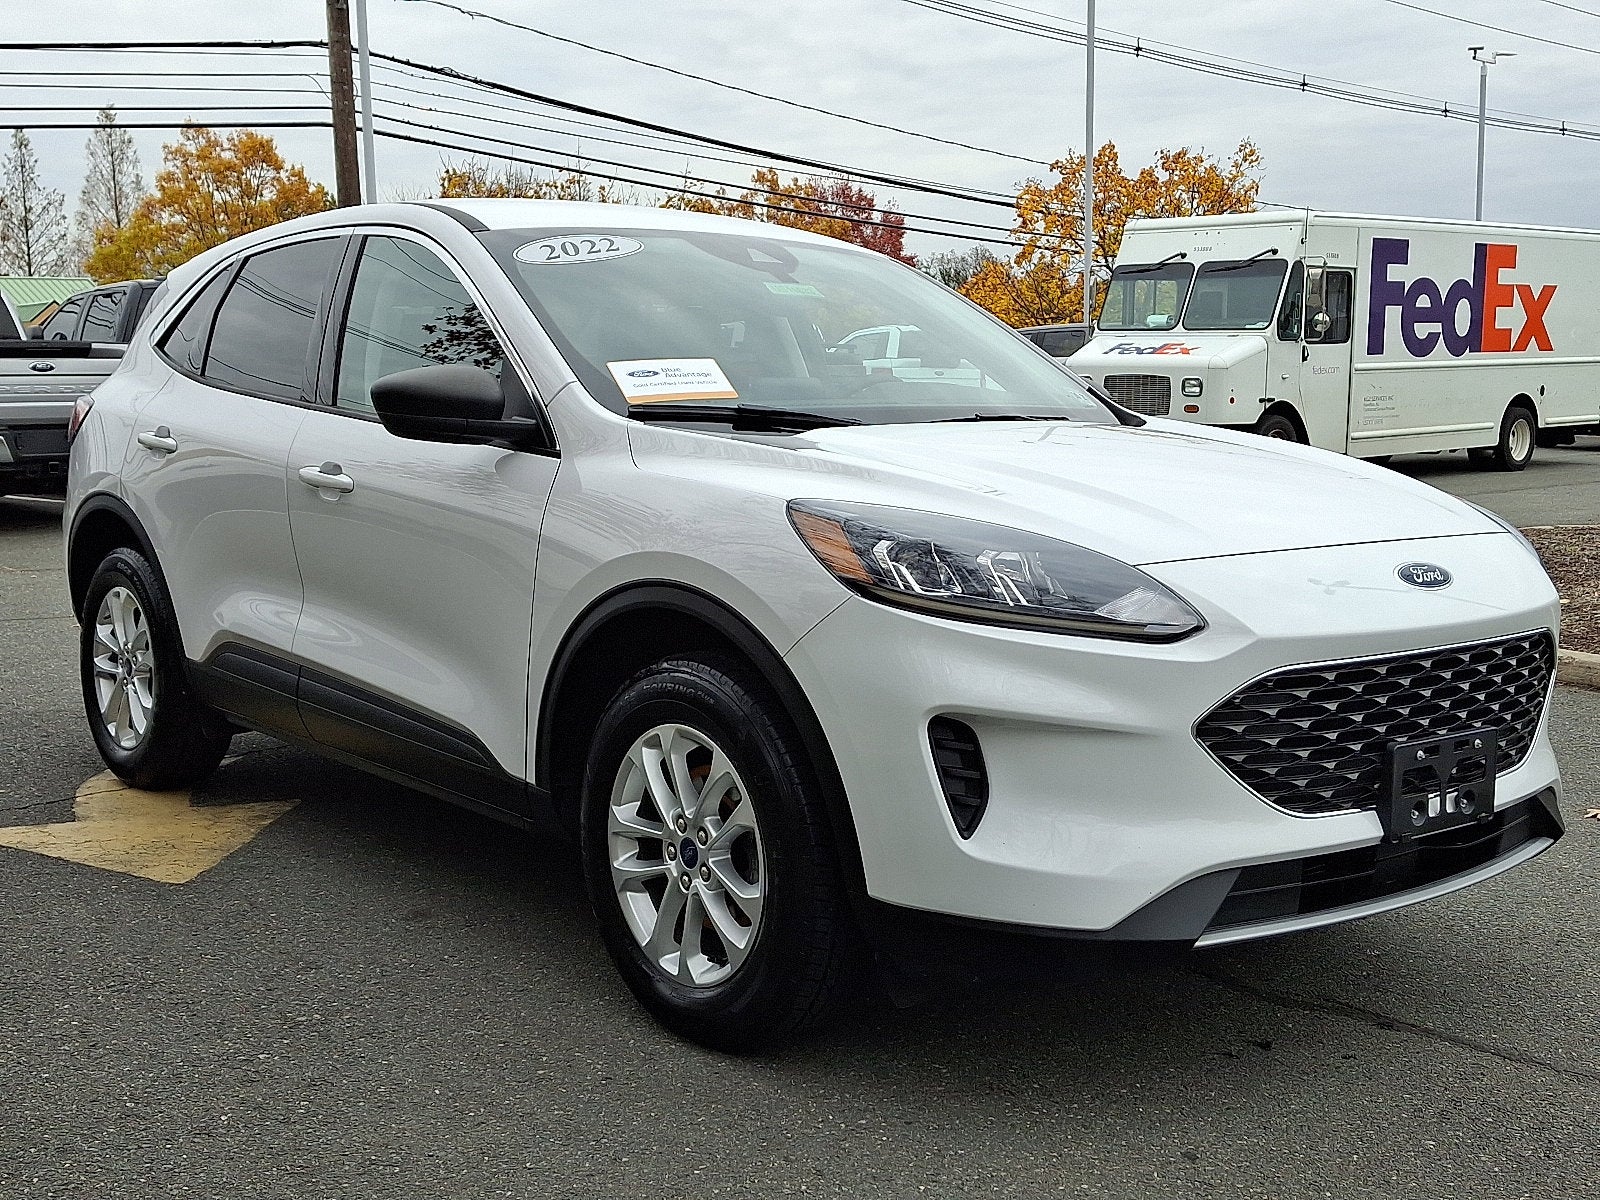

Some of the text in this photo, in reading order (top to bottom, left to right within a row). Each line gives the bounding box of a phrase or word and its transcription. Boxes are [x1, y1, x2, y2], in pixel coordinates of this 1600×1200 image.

[539, 238, 620, 260] 2022
[1367, 237, 1558, 357] FedEx
[1102, 343, 1201, 355] FedEx
[1312, 365, 1340, 374] fedex.com
[1410, 565, 1444, 583] Ford
[643, 682, 696, 696] TOURING
